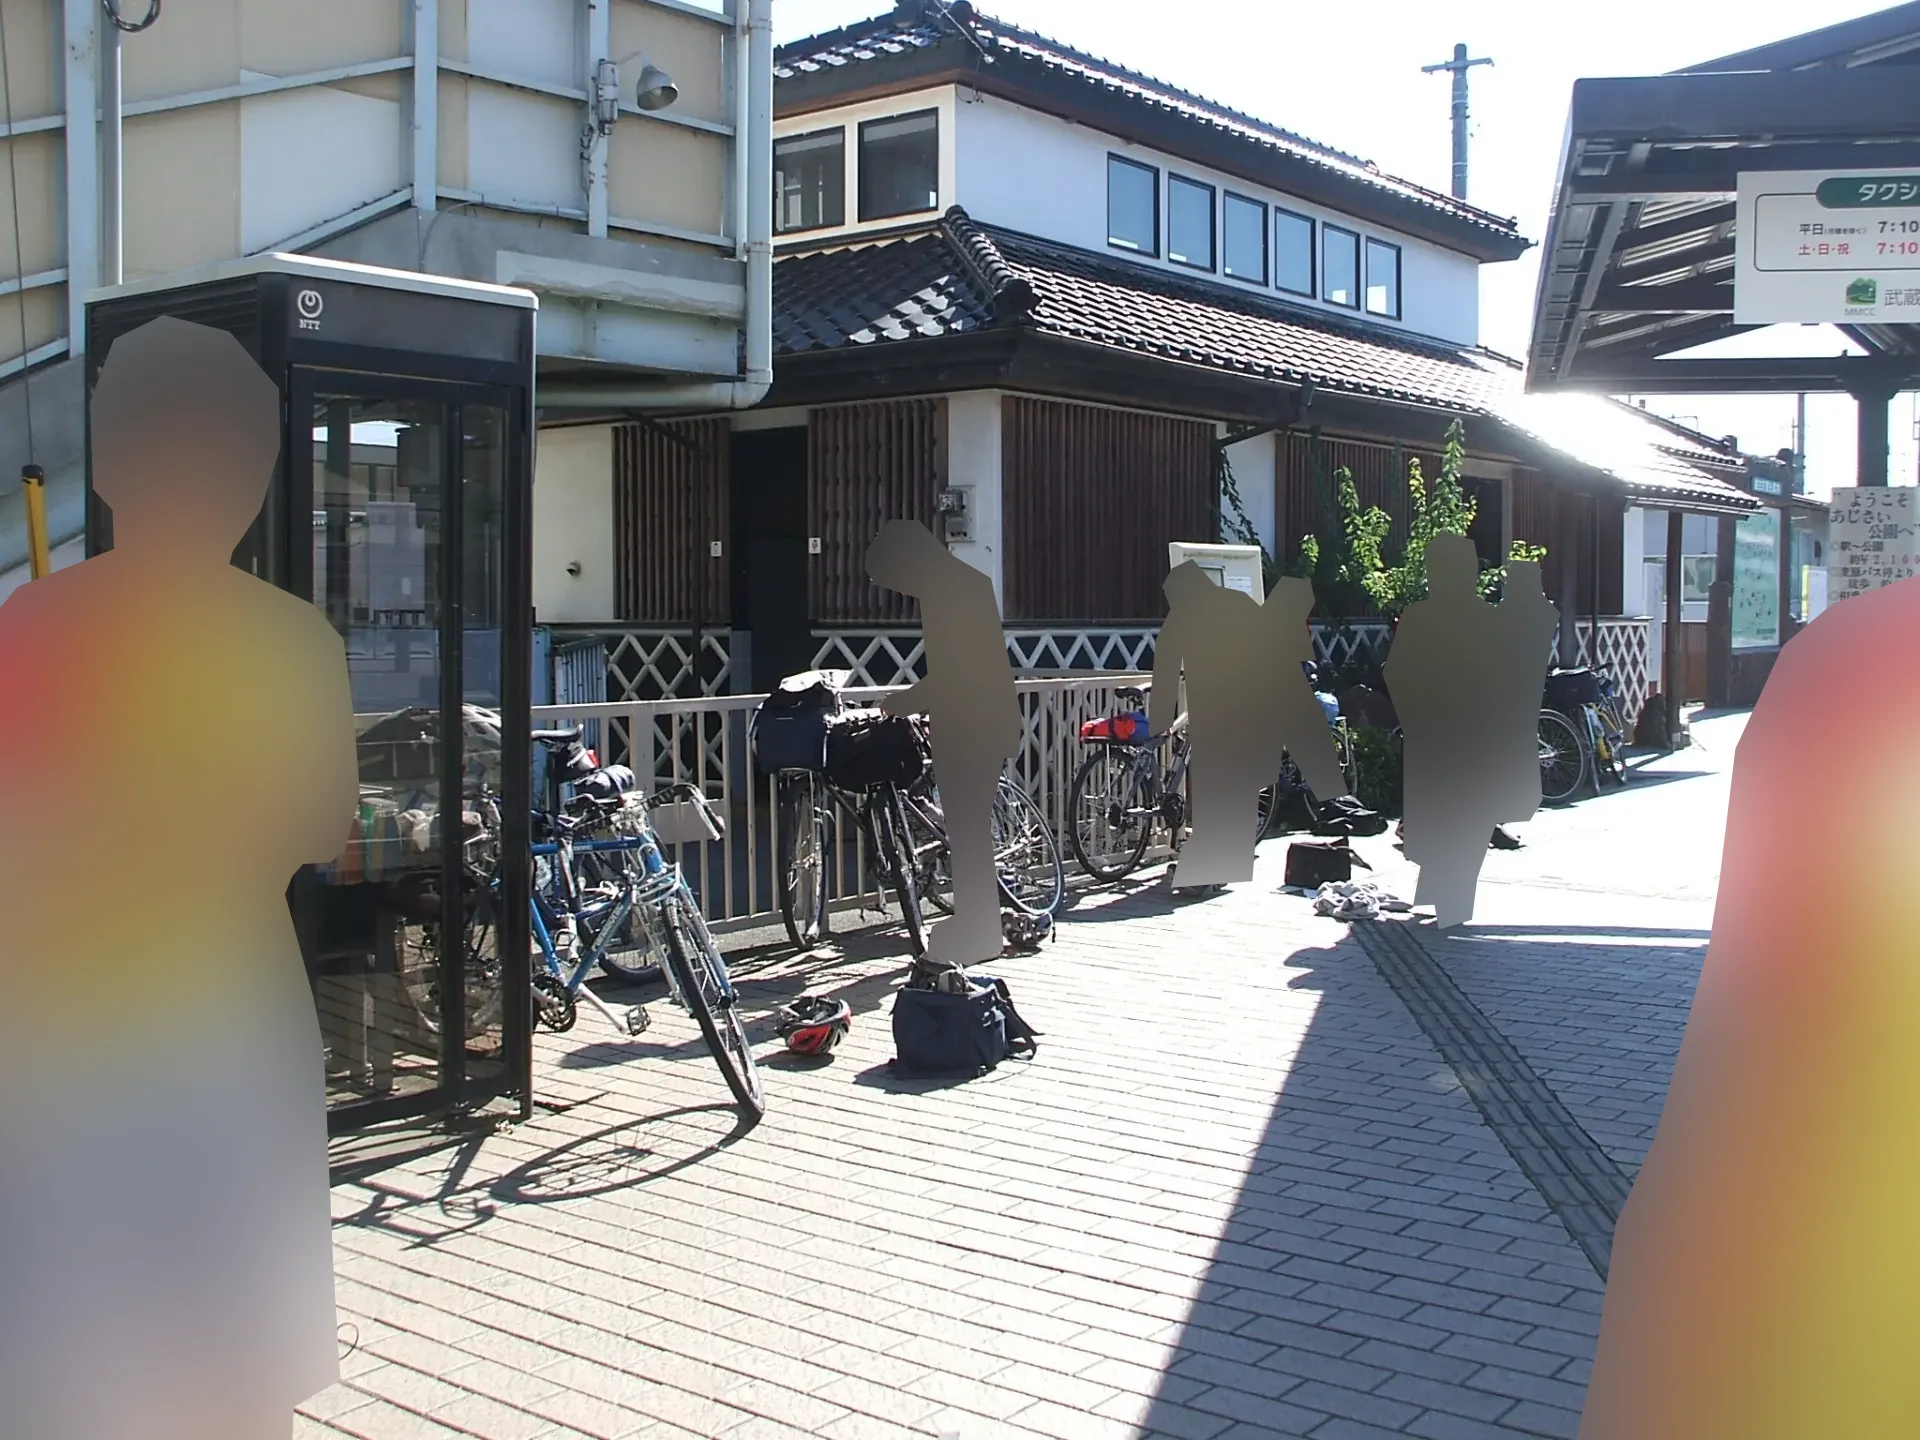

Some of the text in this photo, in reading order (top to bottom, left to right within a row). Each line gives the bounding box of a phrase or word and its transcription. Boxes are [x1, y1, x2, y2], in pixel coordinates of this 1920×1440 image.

[1859, 183, 1920, 201] タクシ
[1799, 223, 1823, 235] 平日
[1877, 242, 1918, 255] 7:10
[299, 319, 321, 330] NTT
[1830, 509, 1891, 524] あじさい
